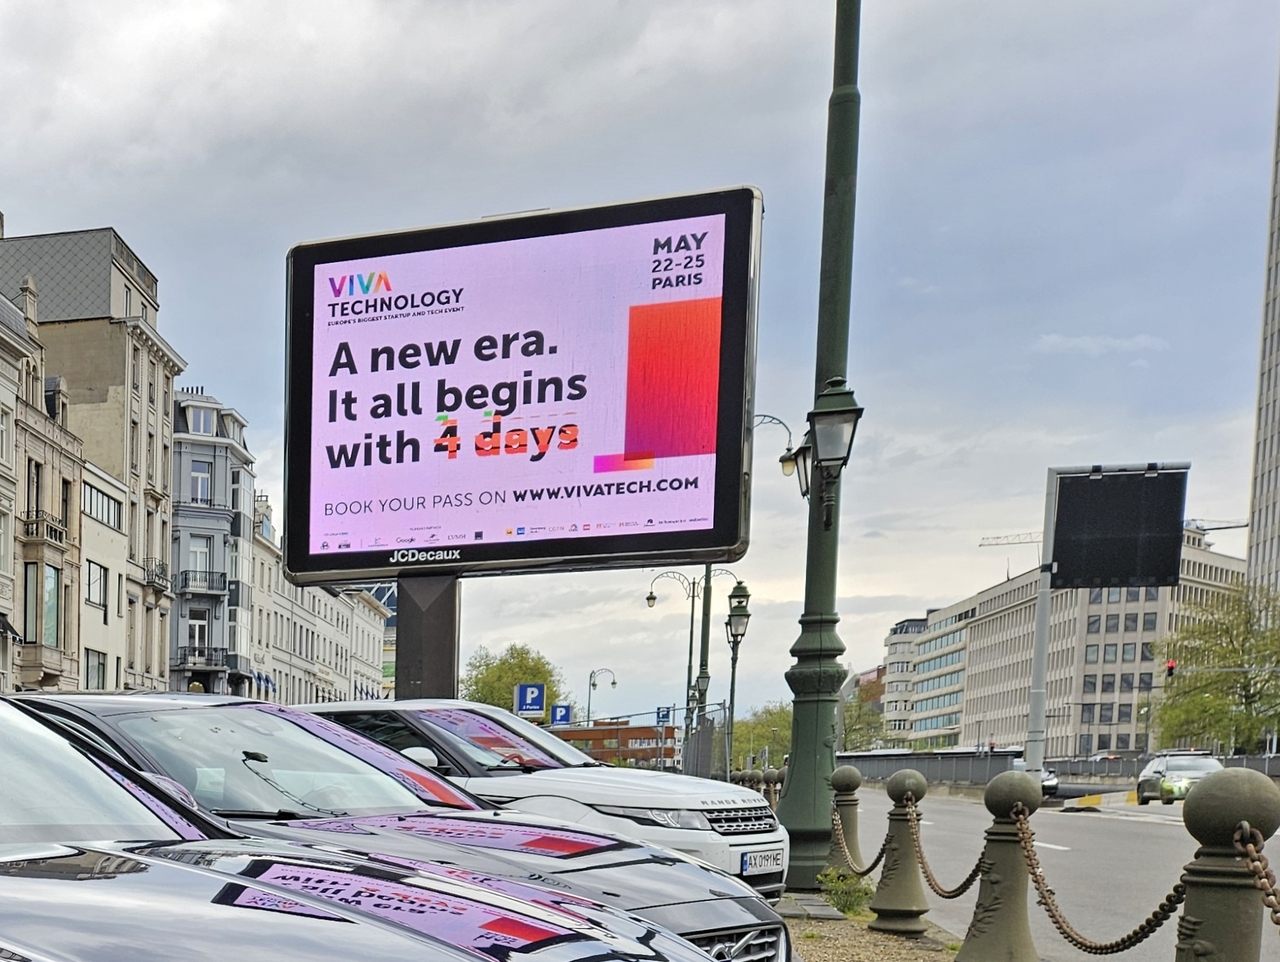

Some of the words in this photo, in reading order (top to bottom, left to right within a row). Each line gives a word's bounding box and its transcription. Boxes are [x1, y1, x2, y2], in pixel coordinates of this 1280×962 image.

[653, 231, 709, 255] MAY
[651, 254, 705, 273] 22-25
[328, 270, 392, 298] VIVA
[651, 272, 703, 290] PARIS
[327, 287, 464, 317] TECHNOLOGY
[357, 315, 383, 324] BIGGEST
[384, 312, 411, 321] STARTUP
[444, 306, 465, 314] EVENT
[328, 342, 358, 377] A
[370, 338, 462, 373] new
[474, 330, 558, 361] era.
[328, 389, 357, 422] It
[370, 381, 422, 419] all
[436, 370, 587, 417] begins
[325, 430, 420, 469] with
[433, 419, 461, 459] 4
[474, 414, 579, 462] days
[324, 500, 373, 516] BOOK
[379, 496, 427, 512] YOUR
[432, 492, 473, 508] PASS
[478, 490, 506, 505] ON
[513, 476, 699, 502] WWW.VIVATECH.COM
[389, 549, 461, 563] JCDecaux
[526, 687, 539, 704] P
[556, 707, 566, 720] P
